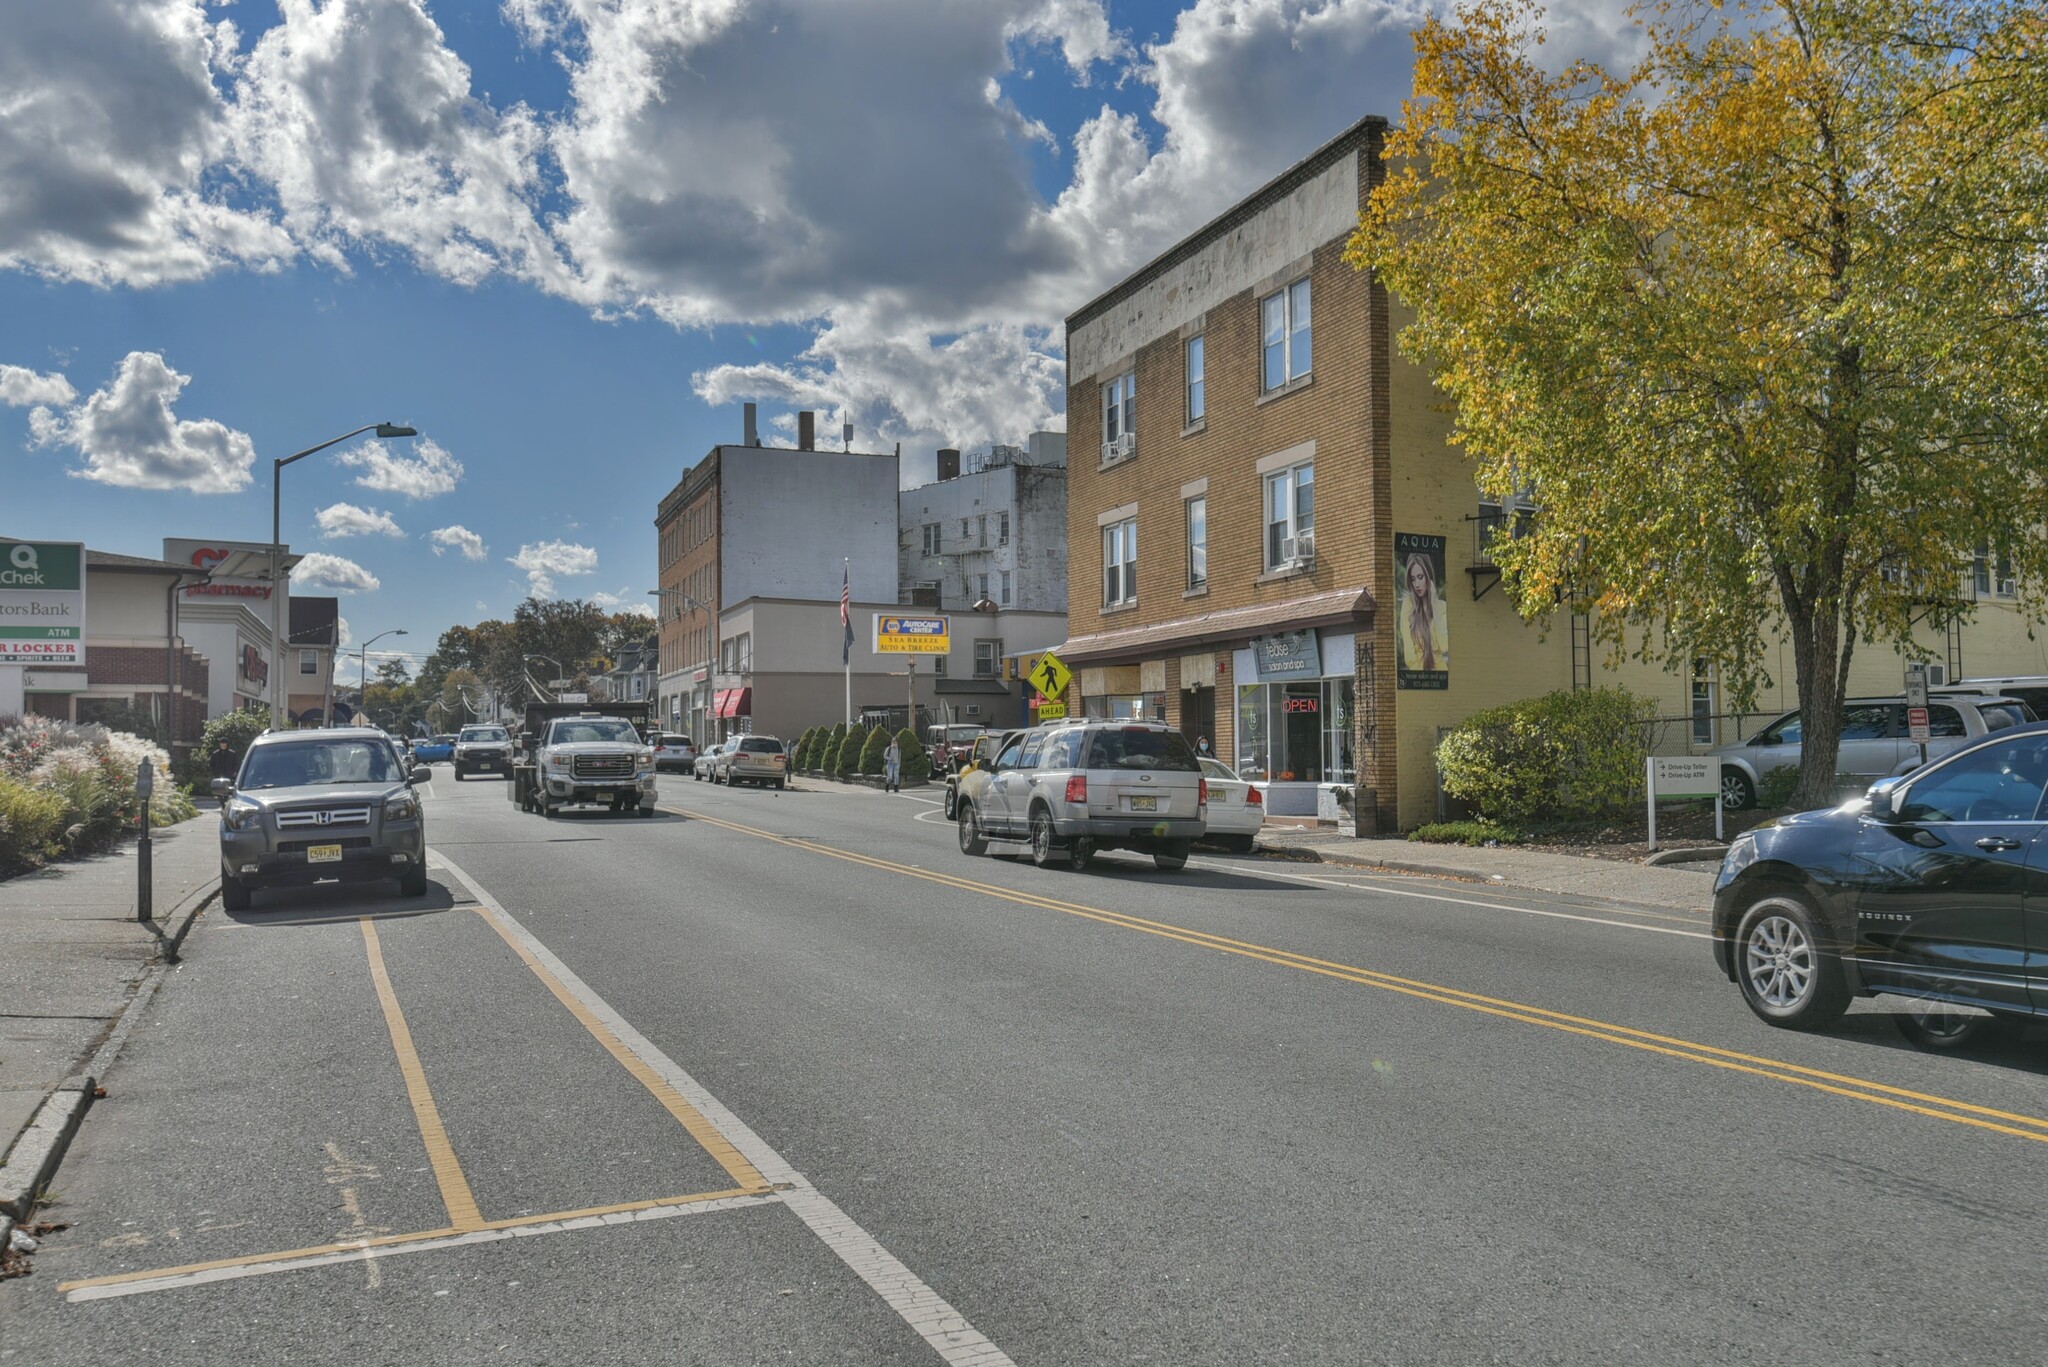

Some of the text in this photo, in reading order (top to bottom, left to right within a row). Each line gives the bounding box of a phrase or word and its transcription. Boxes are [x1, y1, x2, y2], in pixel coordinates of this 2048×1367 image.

[1401, 536, 1439, 548] AQUA
[0, 570, 45, 584] Chek
[186, 583, 273, 600] pharmacy
[48, 629, 70, 637] ATM
[13, 644, 76, 653] LOCKER
[1266, 643, 1288, 657] tease
[1269, 658, 1305, 671] salon and spa
[1041, 707, 1064, 716] AHEAD
[1283, 700, 1317, 712] OPEN
[1858, 912, 1912, 921] EQUINOX
